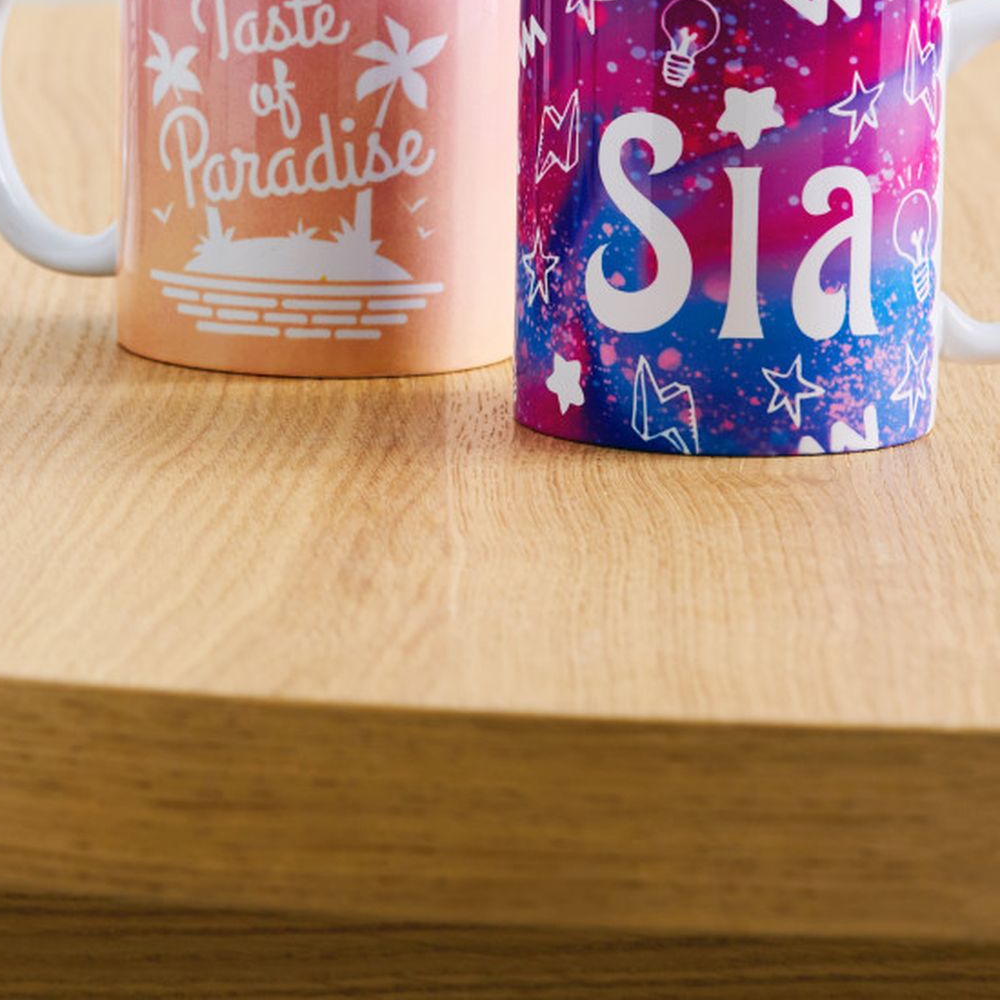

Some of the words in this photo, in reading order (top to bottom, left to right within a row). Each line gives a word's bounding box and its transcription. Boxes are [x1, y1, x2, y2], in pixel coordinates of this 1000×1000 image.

[249, 58, 301, 139] of
[159, 105, 435, 209] Paradise
[585, 87, 880, 340] Sia
